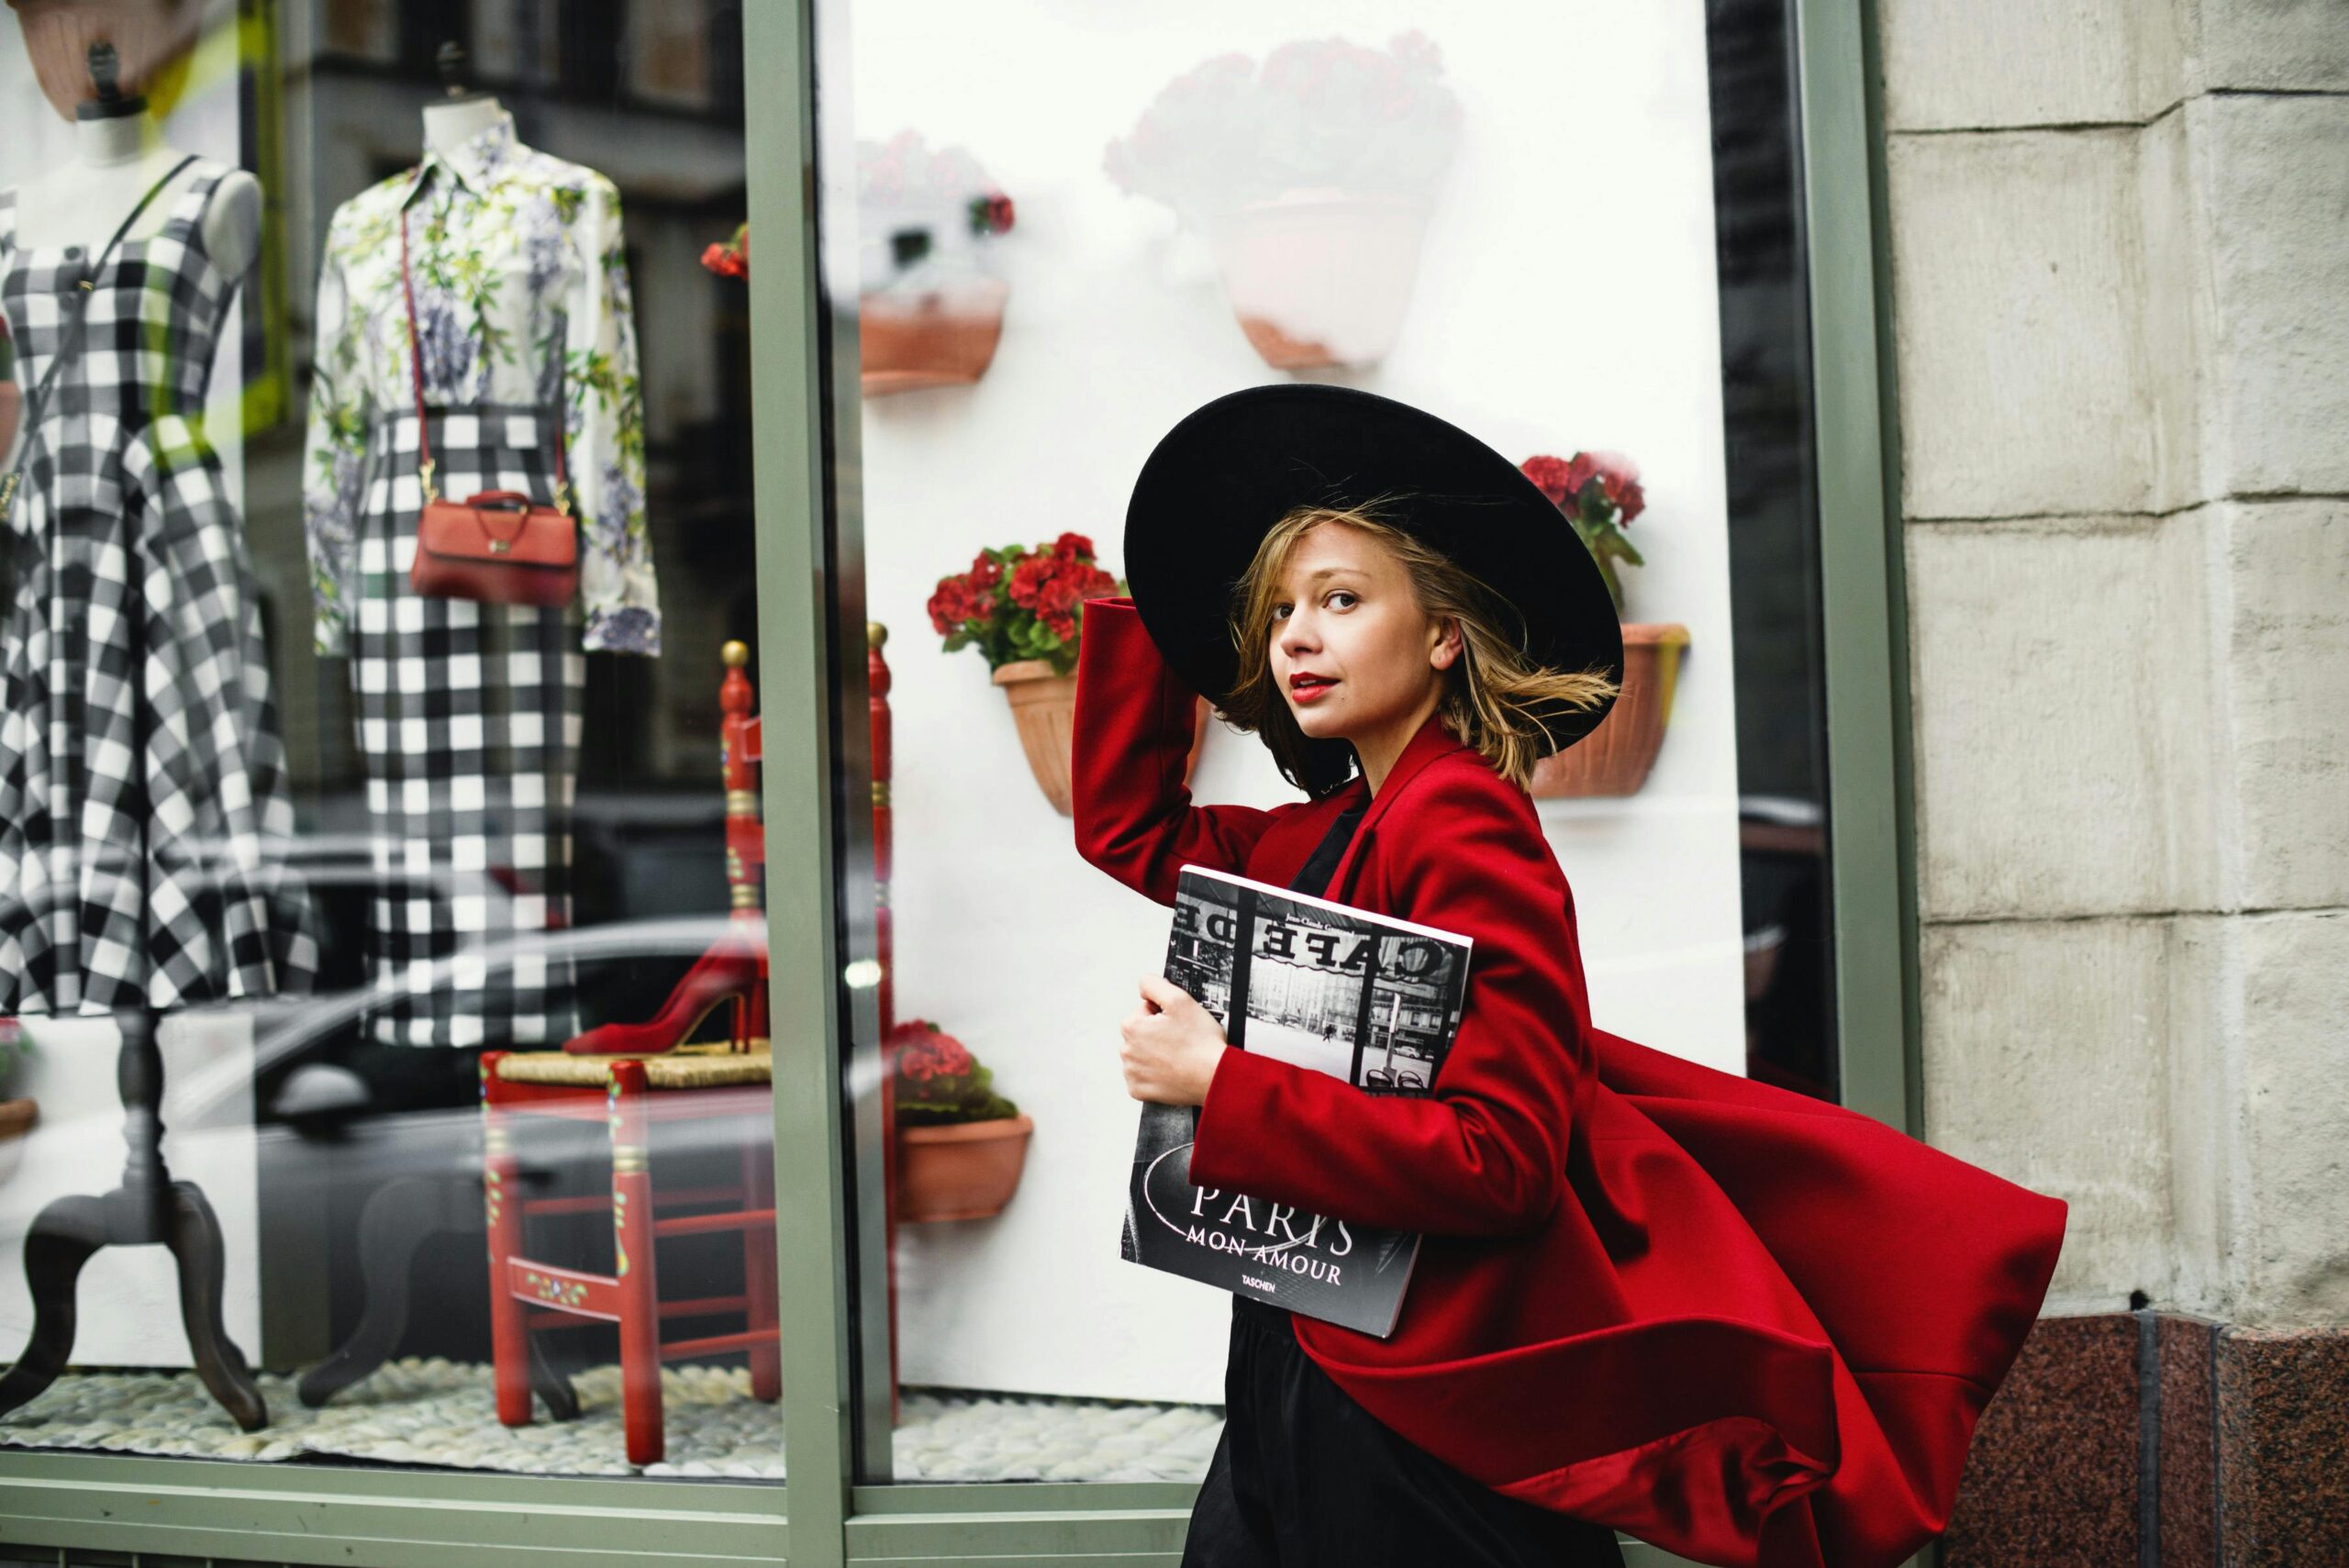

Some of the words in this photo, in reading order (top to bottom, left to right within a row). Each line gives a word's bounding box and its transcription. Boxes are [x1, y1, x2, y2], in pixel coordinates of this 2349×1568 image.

[1191, 1185, 1353, 1256] PARIS
[1186, 1225, 1247, 1257] MON
[1252, 1245, 1341, 1286] AMOUR
[1241, 1273, 1276, 1293] TASCHEN
